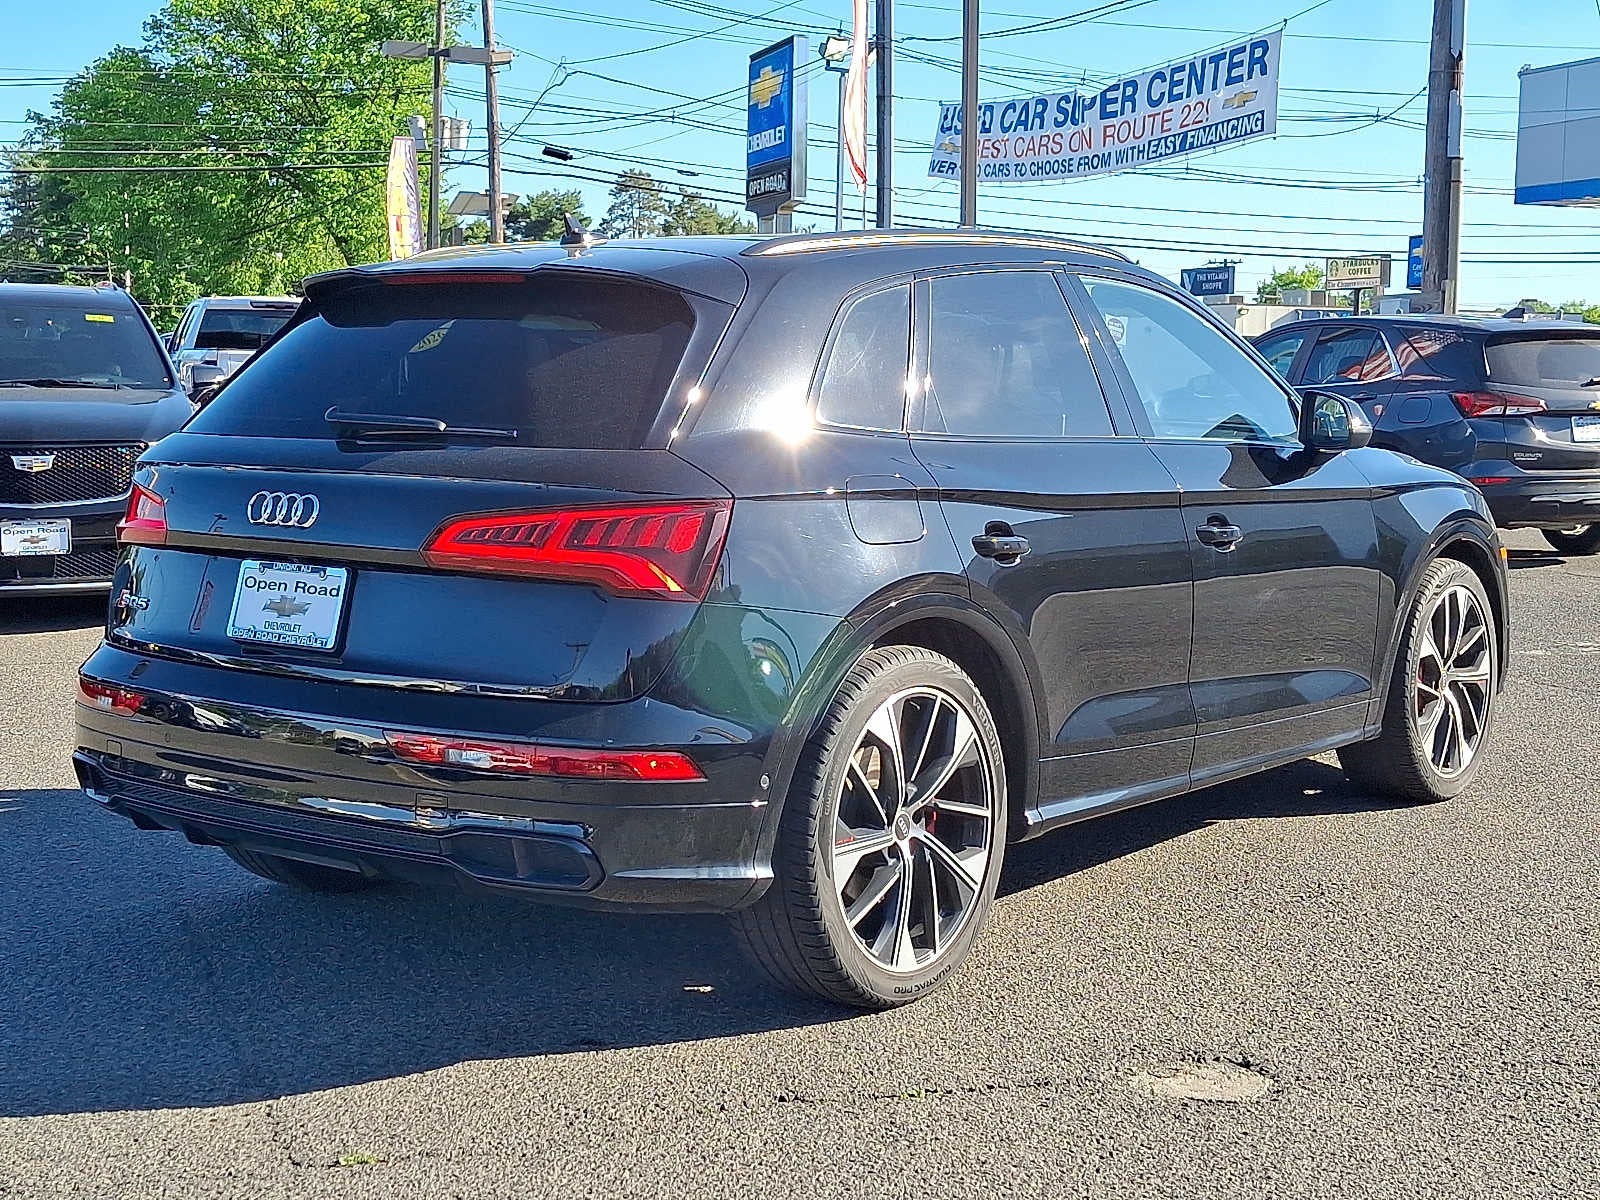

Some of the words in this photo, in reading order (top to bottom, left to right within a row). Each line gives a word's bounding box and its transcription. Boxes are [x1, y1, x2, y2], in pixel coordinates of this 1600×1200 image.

[1000, 97, 1048, 134] CAR
[1147, 40, 1269, 108] CENTER
[748, 125, 785, 154] CHEVROLET
[1014, 132, 1063, 158] CARS
[1069, 127, 1092, 153] ON
[1103, 108, 1173, 148] ROUTE
[930, 160, 957, 175] VER
[984, 163, 1011, 178] CARS
[1014, 163, 1027, 177] TO
[1030, 157, 1074, 176] CHOOSE
[1077, 152, 1111, 173] FROM
[1115, 144, 1146, 165] WITH
[1148, 133, 1185, 158] EASY
[1186, 112, 1263, 150] FINANCING
[749, 179, 765, 196] OPEN
[765, 174, 783, 192] ROAD
[1342, 260, 1379, 268] STARBUCKS
[1348, 267, 1371, 276] COFFEE
[1196, 273, 1206, 281] THE
[1207, 272, 1229, 280] VITAMIN
[1202, 282, 1223, 290] SHOPPE
[3, 528, 33, 536] Open
[244, 576, 287, 592] Open
[294, 580, 340, 597] Road
[264, 620, 302, 633] CHEVROLET
[232, 627, 254, 639] OPEN
[256, 630, 279, 641] ROAD
[280, 632, 327, 647] CHEVROLET
[914, 964, 952, 992] QUATRAC
[894, 986, 913, 994] PRO
